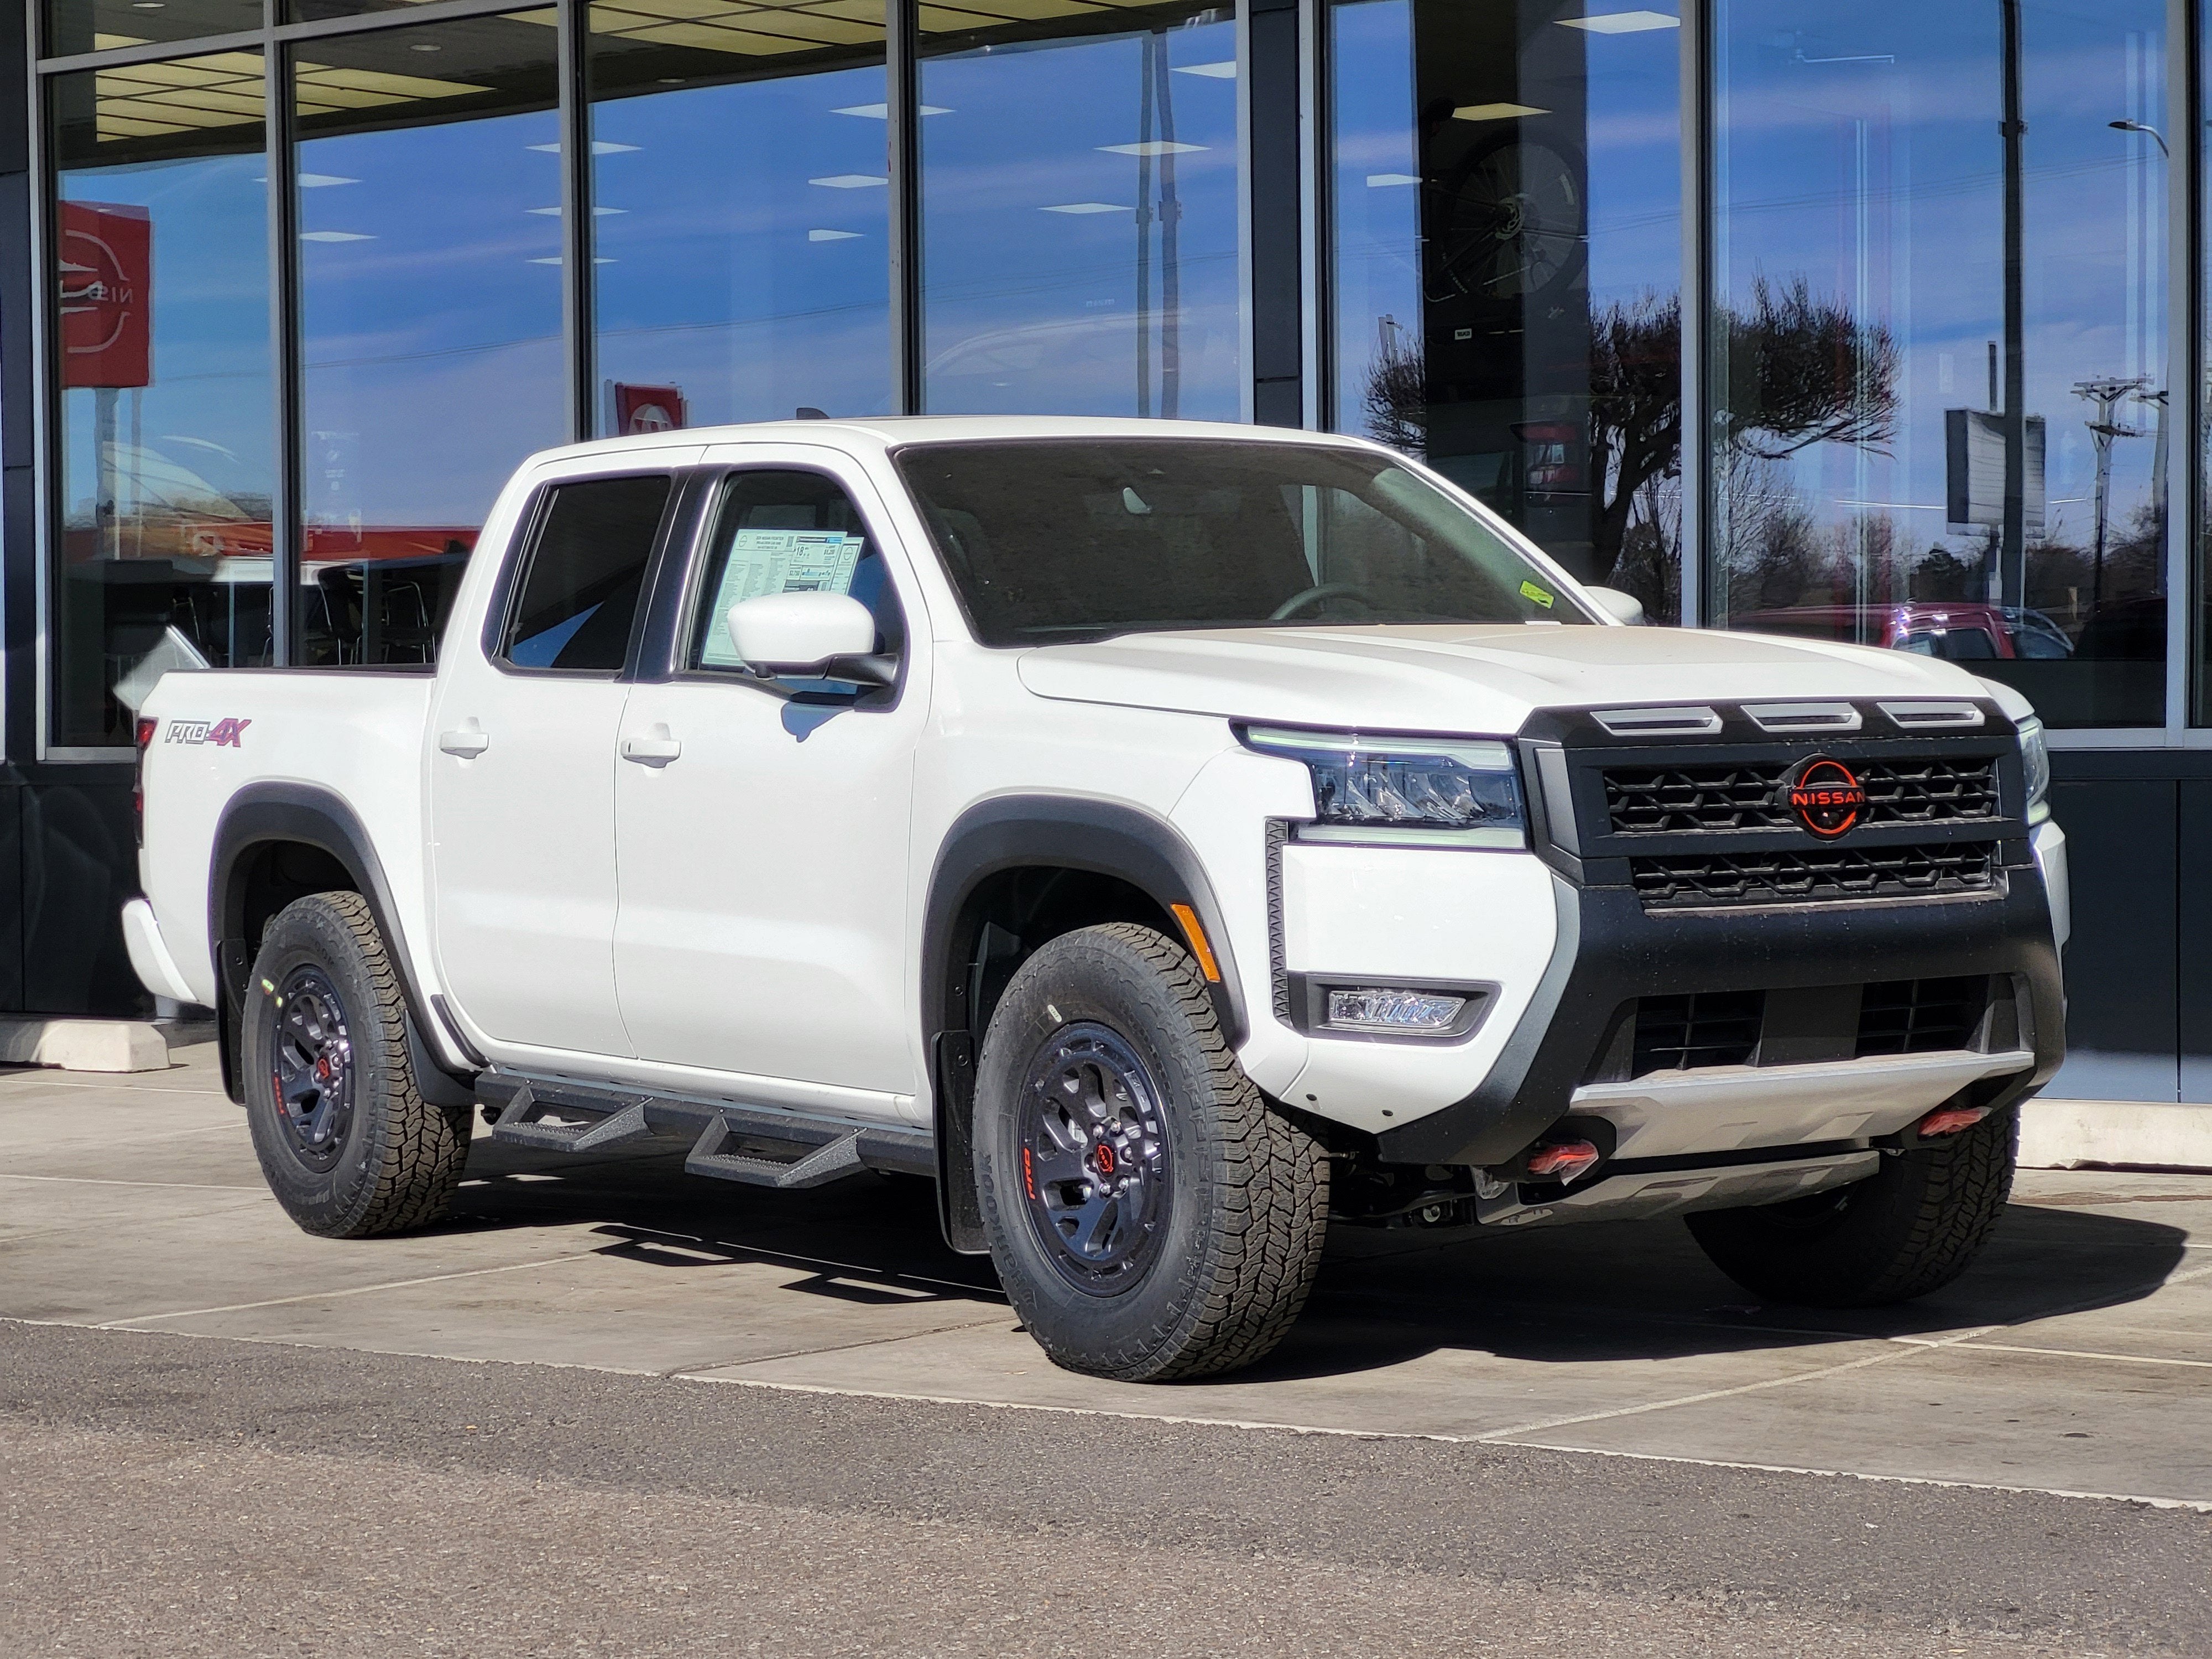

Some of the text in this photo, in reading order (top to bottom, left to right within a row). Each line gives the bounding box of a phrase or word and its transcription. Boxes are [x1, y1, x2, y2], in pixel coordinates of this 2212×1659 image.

[796, 546, 804, 556] 18
[164, 718, 252, 748] PRO-4X
[1792, 791, 1865, 806] NISSAN
[1024, 1147, 1036, 1200] PRO
